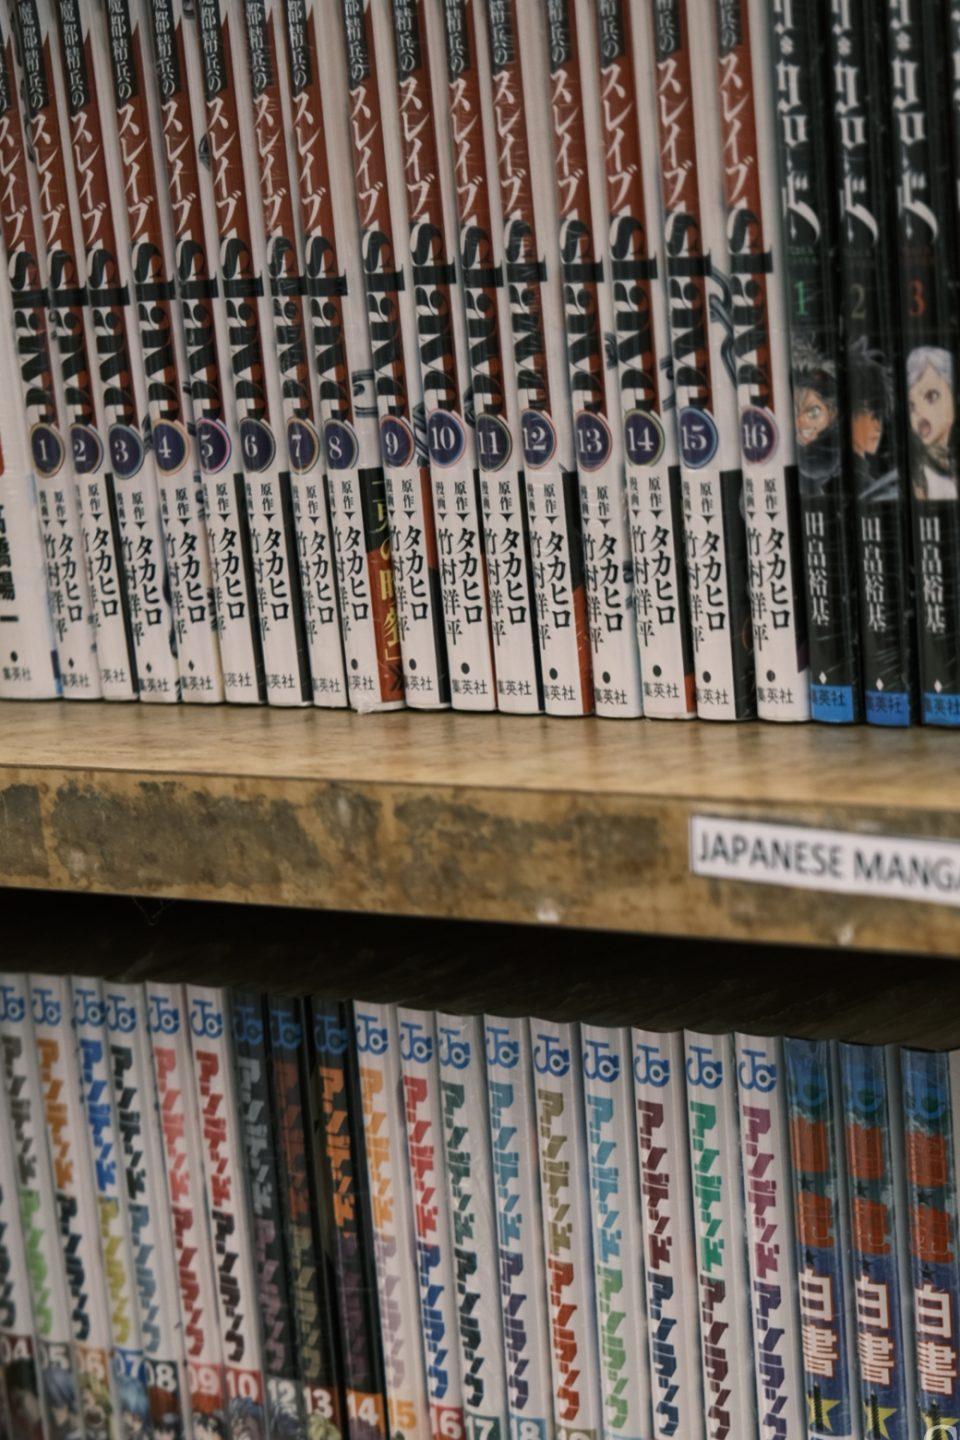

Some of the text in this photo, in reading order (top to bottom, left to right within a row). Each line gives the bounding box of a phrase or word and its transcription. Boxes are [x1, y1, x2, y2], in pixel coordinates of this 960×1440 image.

[39, 442, 48, 461] 1
[158, 437, 172, 457] 4
[244, 436, 258, 457] 6
[328, 436, 343, 458] 8
[432, 426, 455, 450] 10
[522, 427, 546, 450] 12
[627, 426, 654, 451] 14
[682, 425, 707, 450] 15
[744, 424, 768, 449] 16
[59, 533, 82, 622] タカヒロ
[136, 535, 162, 626] タカヒロ
[264, 527, 289, 621] タカヒロ
[403, 524, 428, 621] タカヒロ
[438, 528, 463, 646] 竹村洋平
[457, 527, 482, 625] タカヒロ
[632, 525, 656, 647] 竹村洋平
[651, 525, 675, 625] タカヒロ
[766, 527, 791, 630] タカヒロ
[700, 831, 844, 880] JAPANESE
[226, 1371, 259, 1398] 10
[347, 1394, 378, 1425] 14
[430, 1409, 461, 1439] 16
